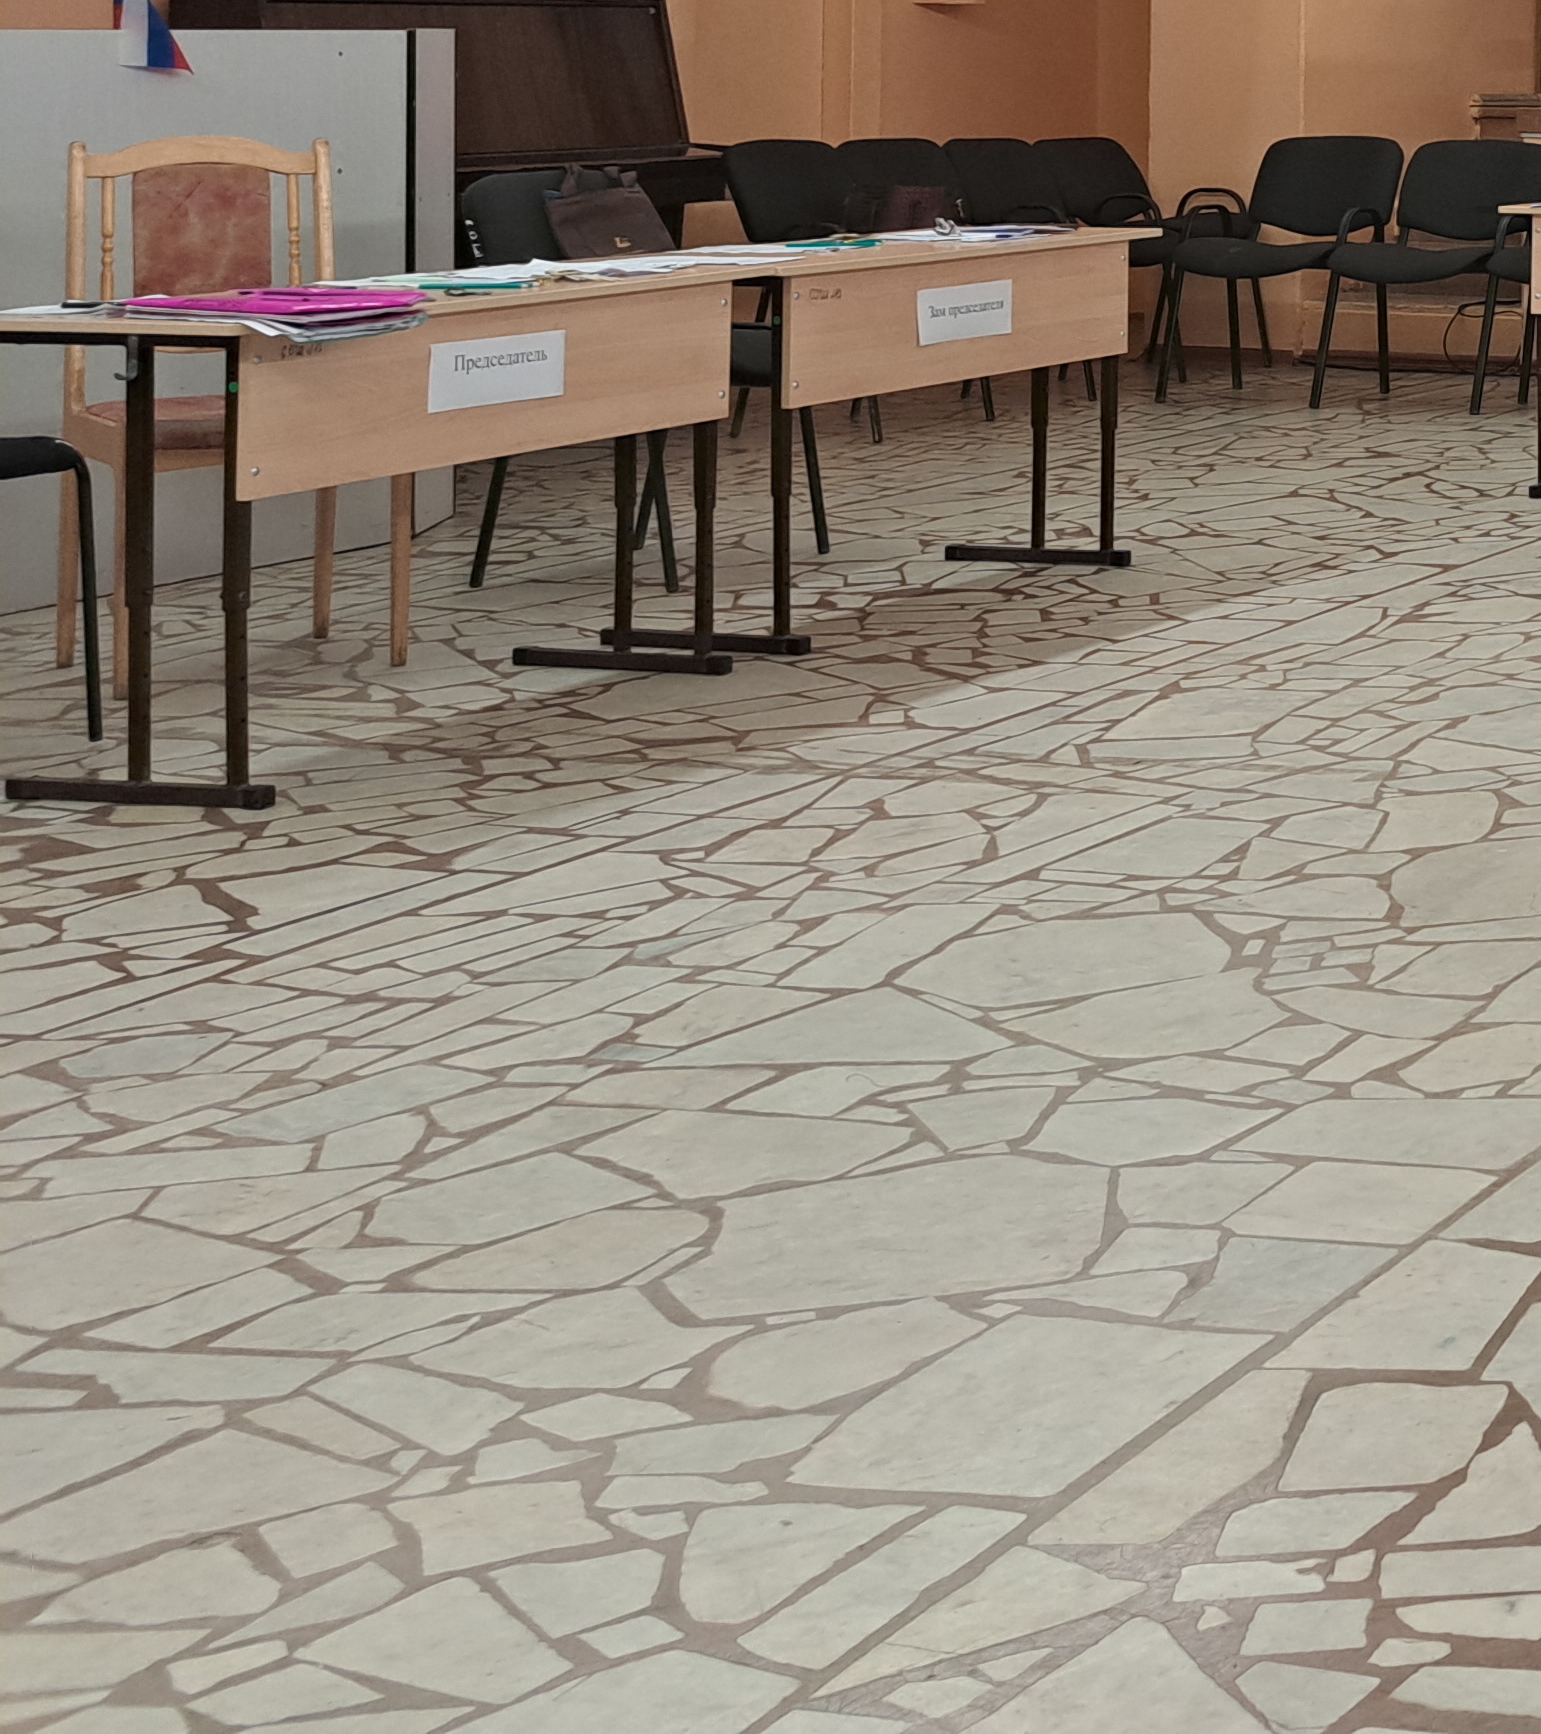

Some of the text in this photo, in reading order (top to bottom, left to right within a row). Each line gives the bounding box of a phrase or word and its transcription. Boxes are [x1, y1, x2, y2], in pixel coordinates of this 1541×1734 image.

[928, 299, 1004, 319] Зам председателя
[453, 346, 549, 375] Председатель
